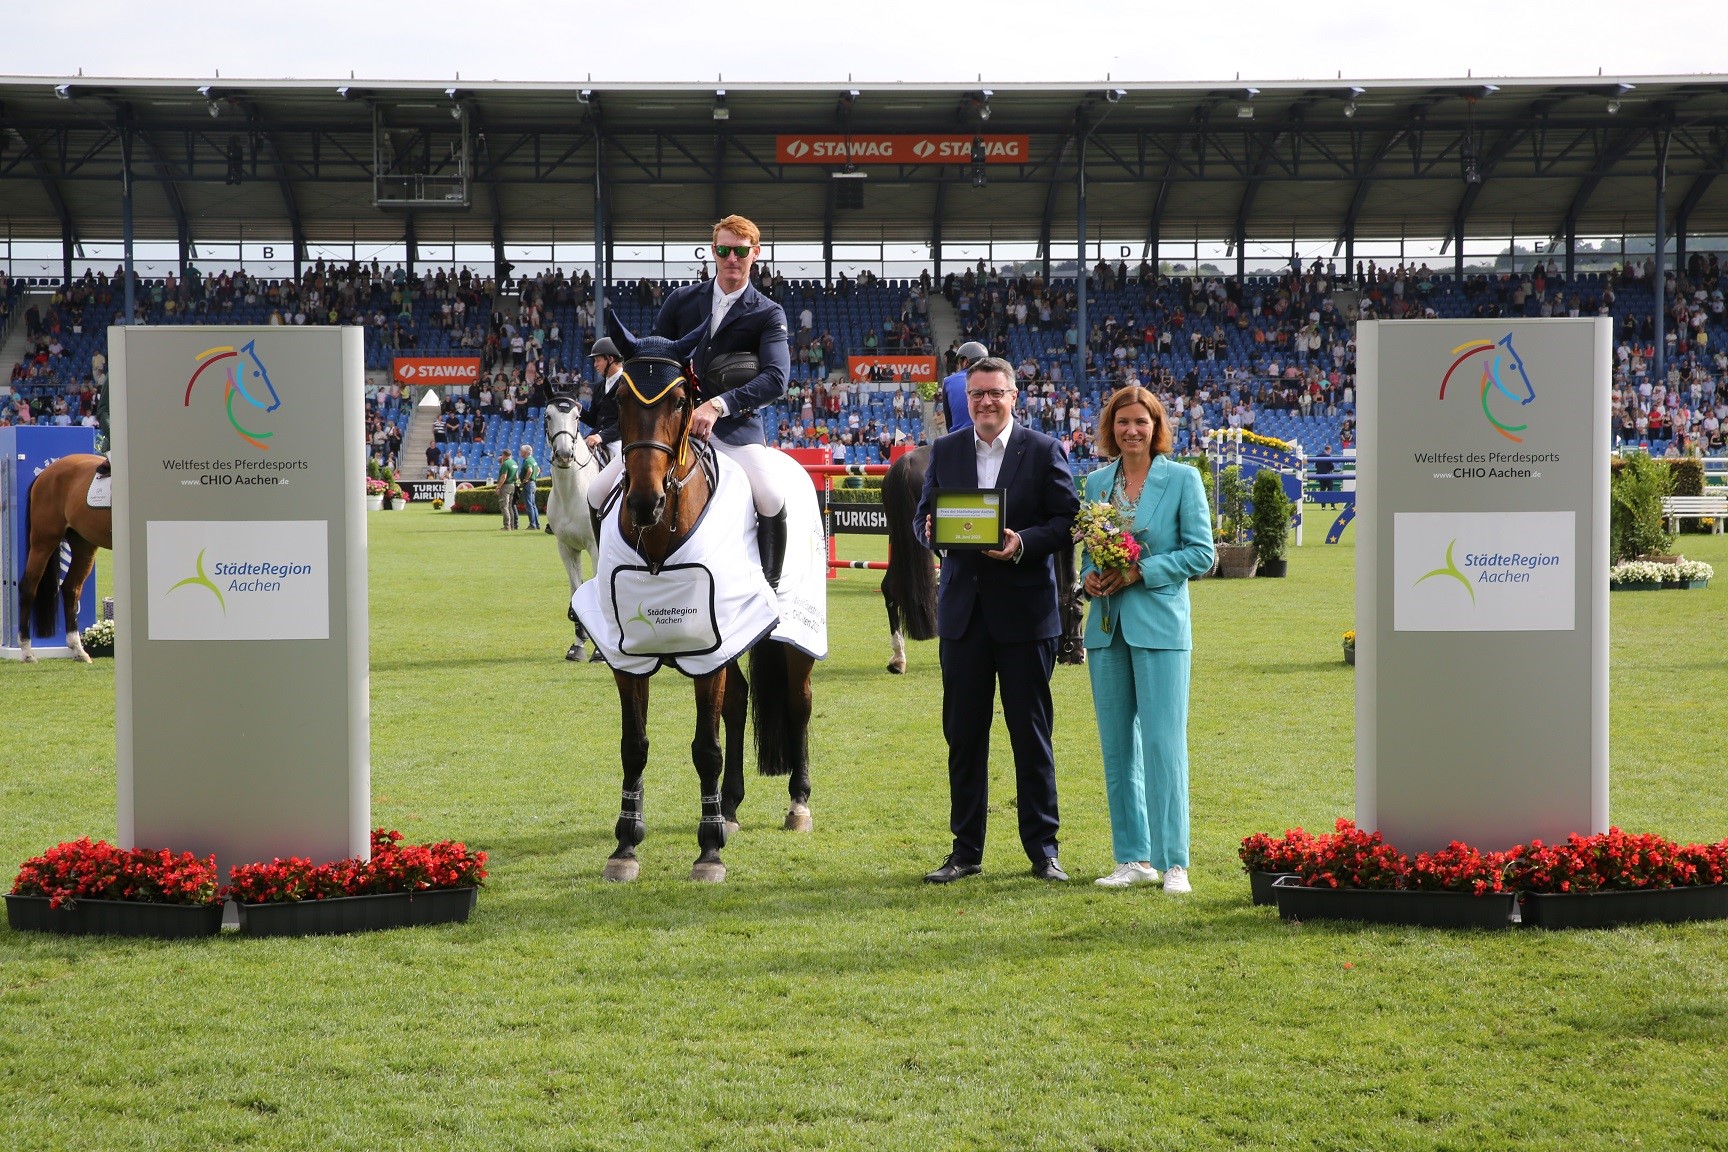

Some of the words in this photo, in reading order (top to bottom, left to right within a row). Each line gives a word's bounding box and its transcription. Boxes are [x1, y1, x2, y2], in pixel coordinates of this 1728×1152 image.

[813, 142, 892, 156] STAWAG
[264, 246, 274, 258] B
[694, 247, 705, 260] C
[1120, 246, 1131, 258] D
[1535, 242, 1544, 254] E
[418, 366, 476, 377] STAWAG
[1414, 452, 1464, 463] Weltfest
[1466, 452, 1486, 462] des
[1489, 452, 1560, 464] Pferdesports
[162, 460, 210, 470] Weltfest
[212, 460, 232, 470] des
[235, 459, 308, 472] Pferdesports
[834, 511, 887, 527] TURKISH
[1464, 553, 1560, 569] StädteRegion
[214, 562, 312, 578] StädteRegion
[1478, 570, 1530, 582] Aachen
[228, 579, 280, 591] Aachen
[648, 607, 698, 616] StädteRegion
